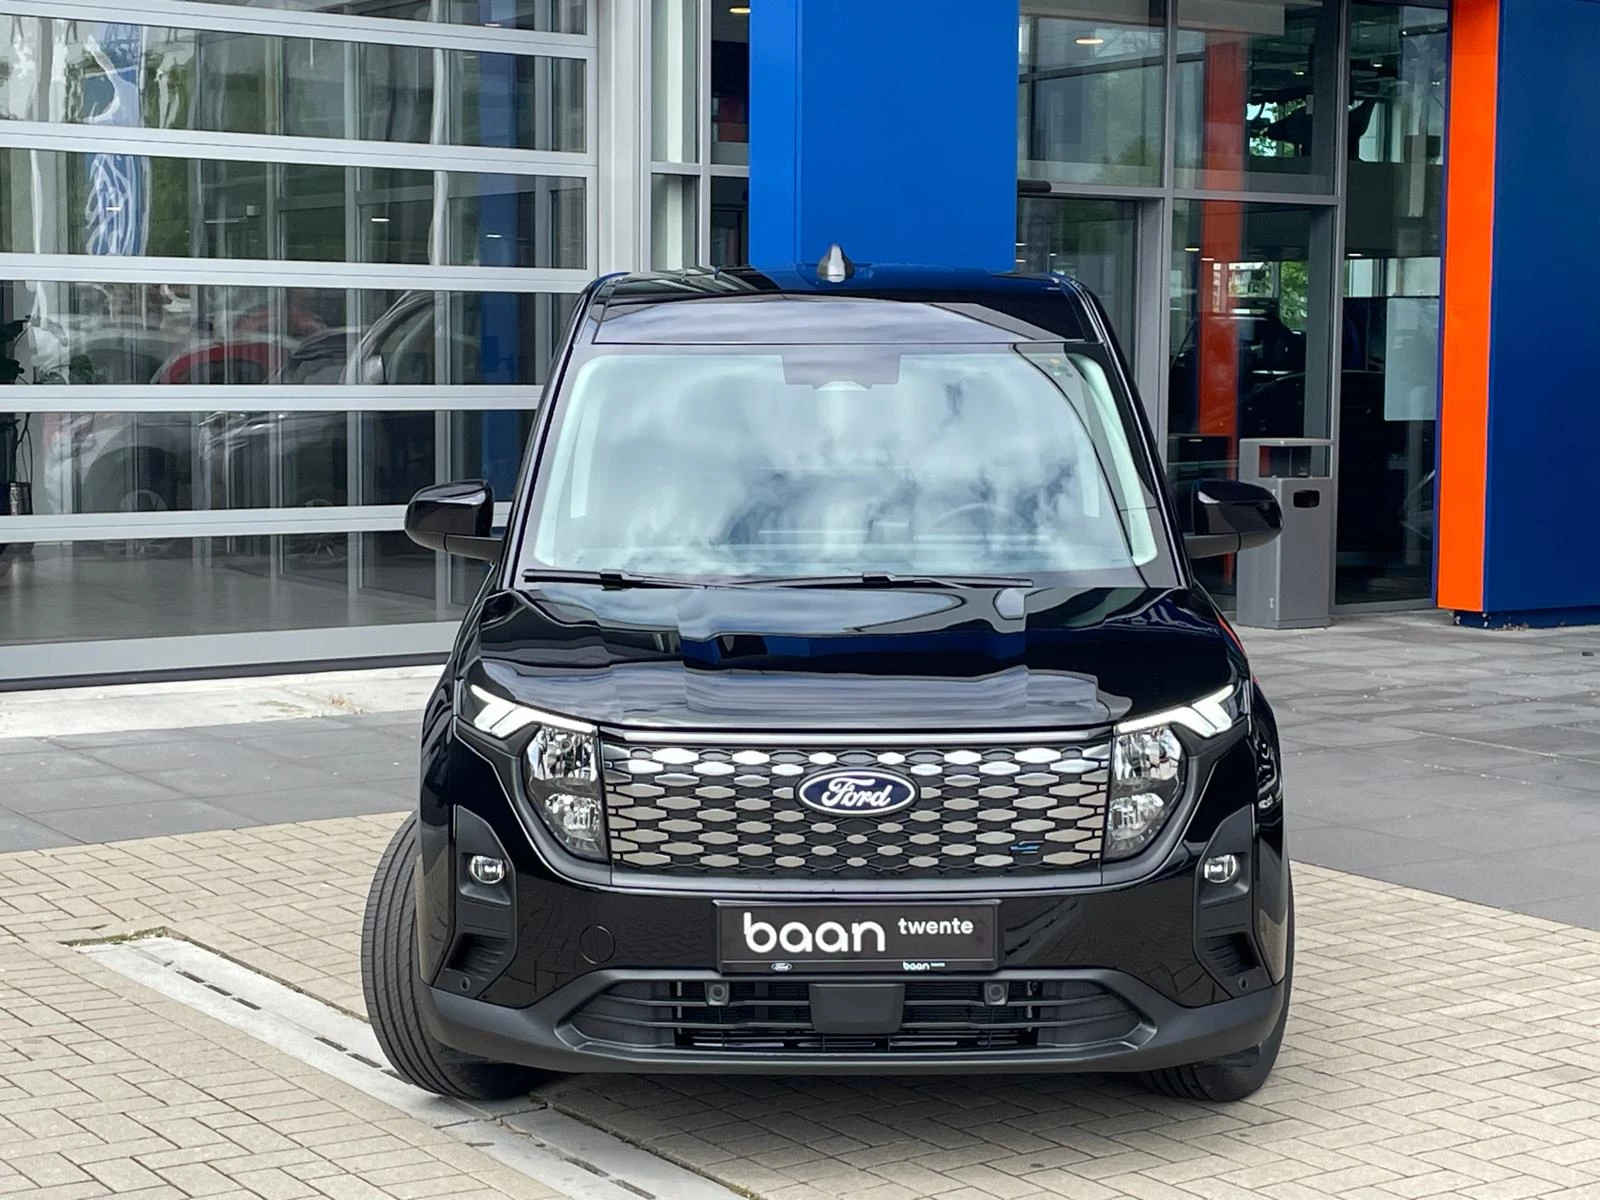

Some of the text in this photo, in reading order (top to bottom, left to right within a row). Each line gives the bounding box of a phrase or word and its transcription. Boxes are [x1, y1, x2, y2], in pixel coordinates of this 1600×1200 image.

[821, 777, 893, 807] Ford
[743, 912, 974, 953] baan twente
[902, 961, 930, 971] baan
